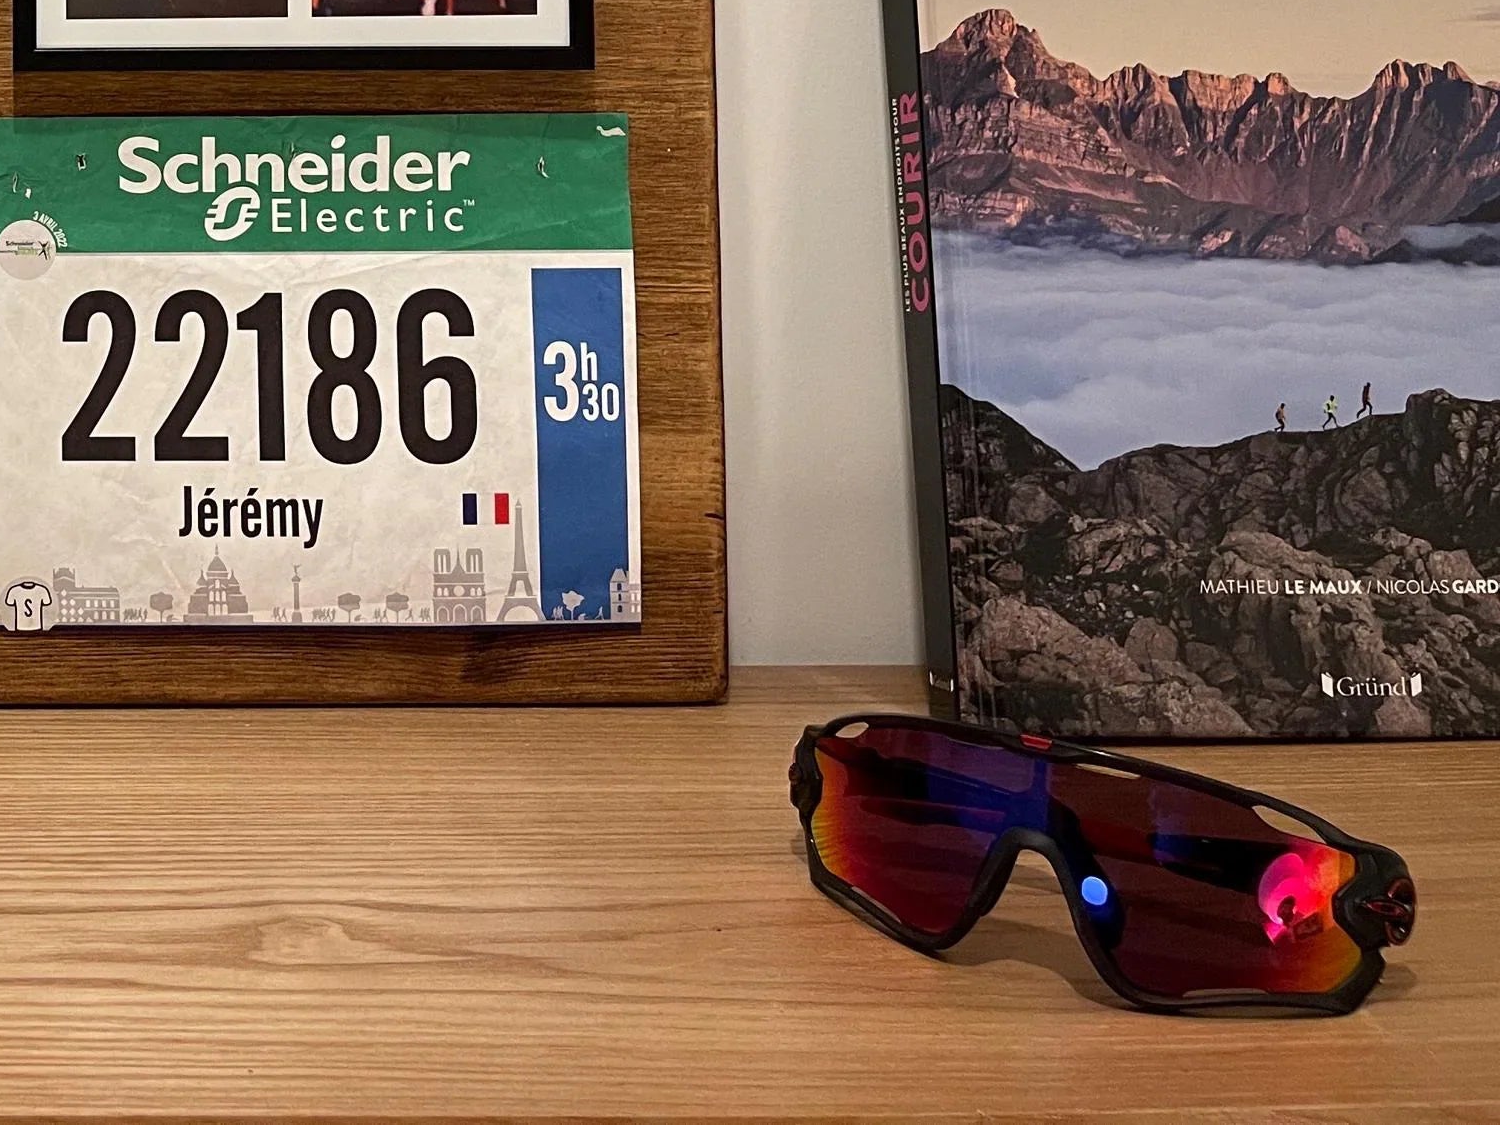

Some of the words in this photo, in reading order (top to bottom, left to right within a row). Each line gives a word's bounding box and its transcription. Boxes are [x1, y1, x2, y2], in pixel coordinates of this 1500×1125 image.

[117, 134, 471, 194] Schneider
[895, 137, 904, 204] ENDROITS
[32, 210, 40, 221] 3
[39, 213, 58, 232] AVRIL
[53, 228, 68, 248] 2022
[900, 91, 929, 312] COURIR
[61, 288, 478, 465] 22186
[178, 485, 324, 549] Jérémy
[24, 598, 33, 617] S
[1199, 579, 1279, 595] MATHIEU
[1284, 579, 1305, 595] LE
[1309, 579, 1363, 595] MAUX
[1376, 579, 1450, 594] NICOLAS
[1336, 676, 1406, 697] Gründ
